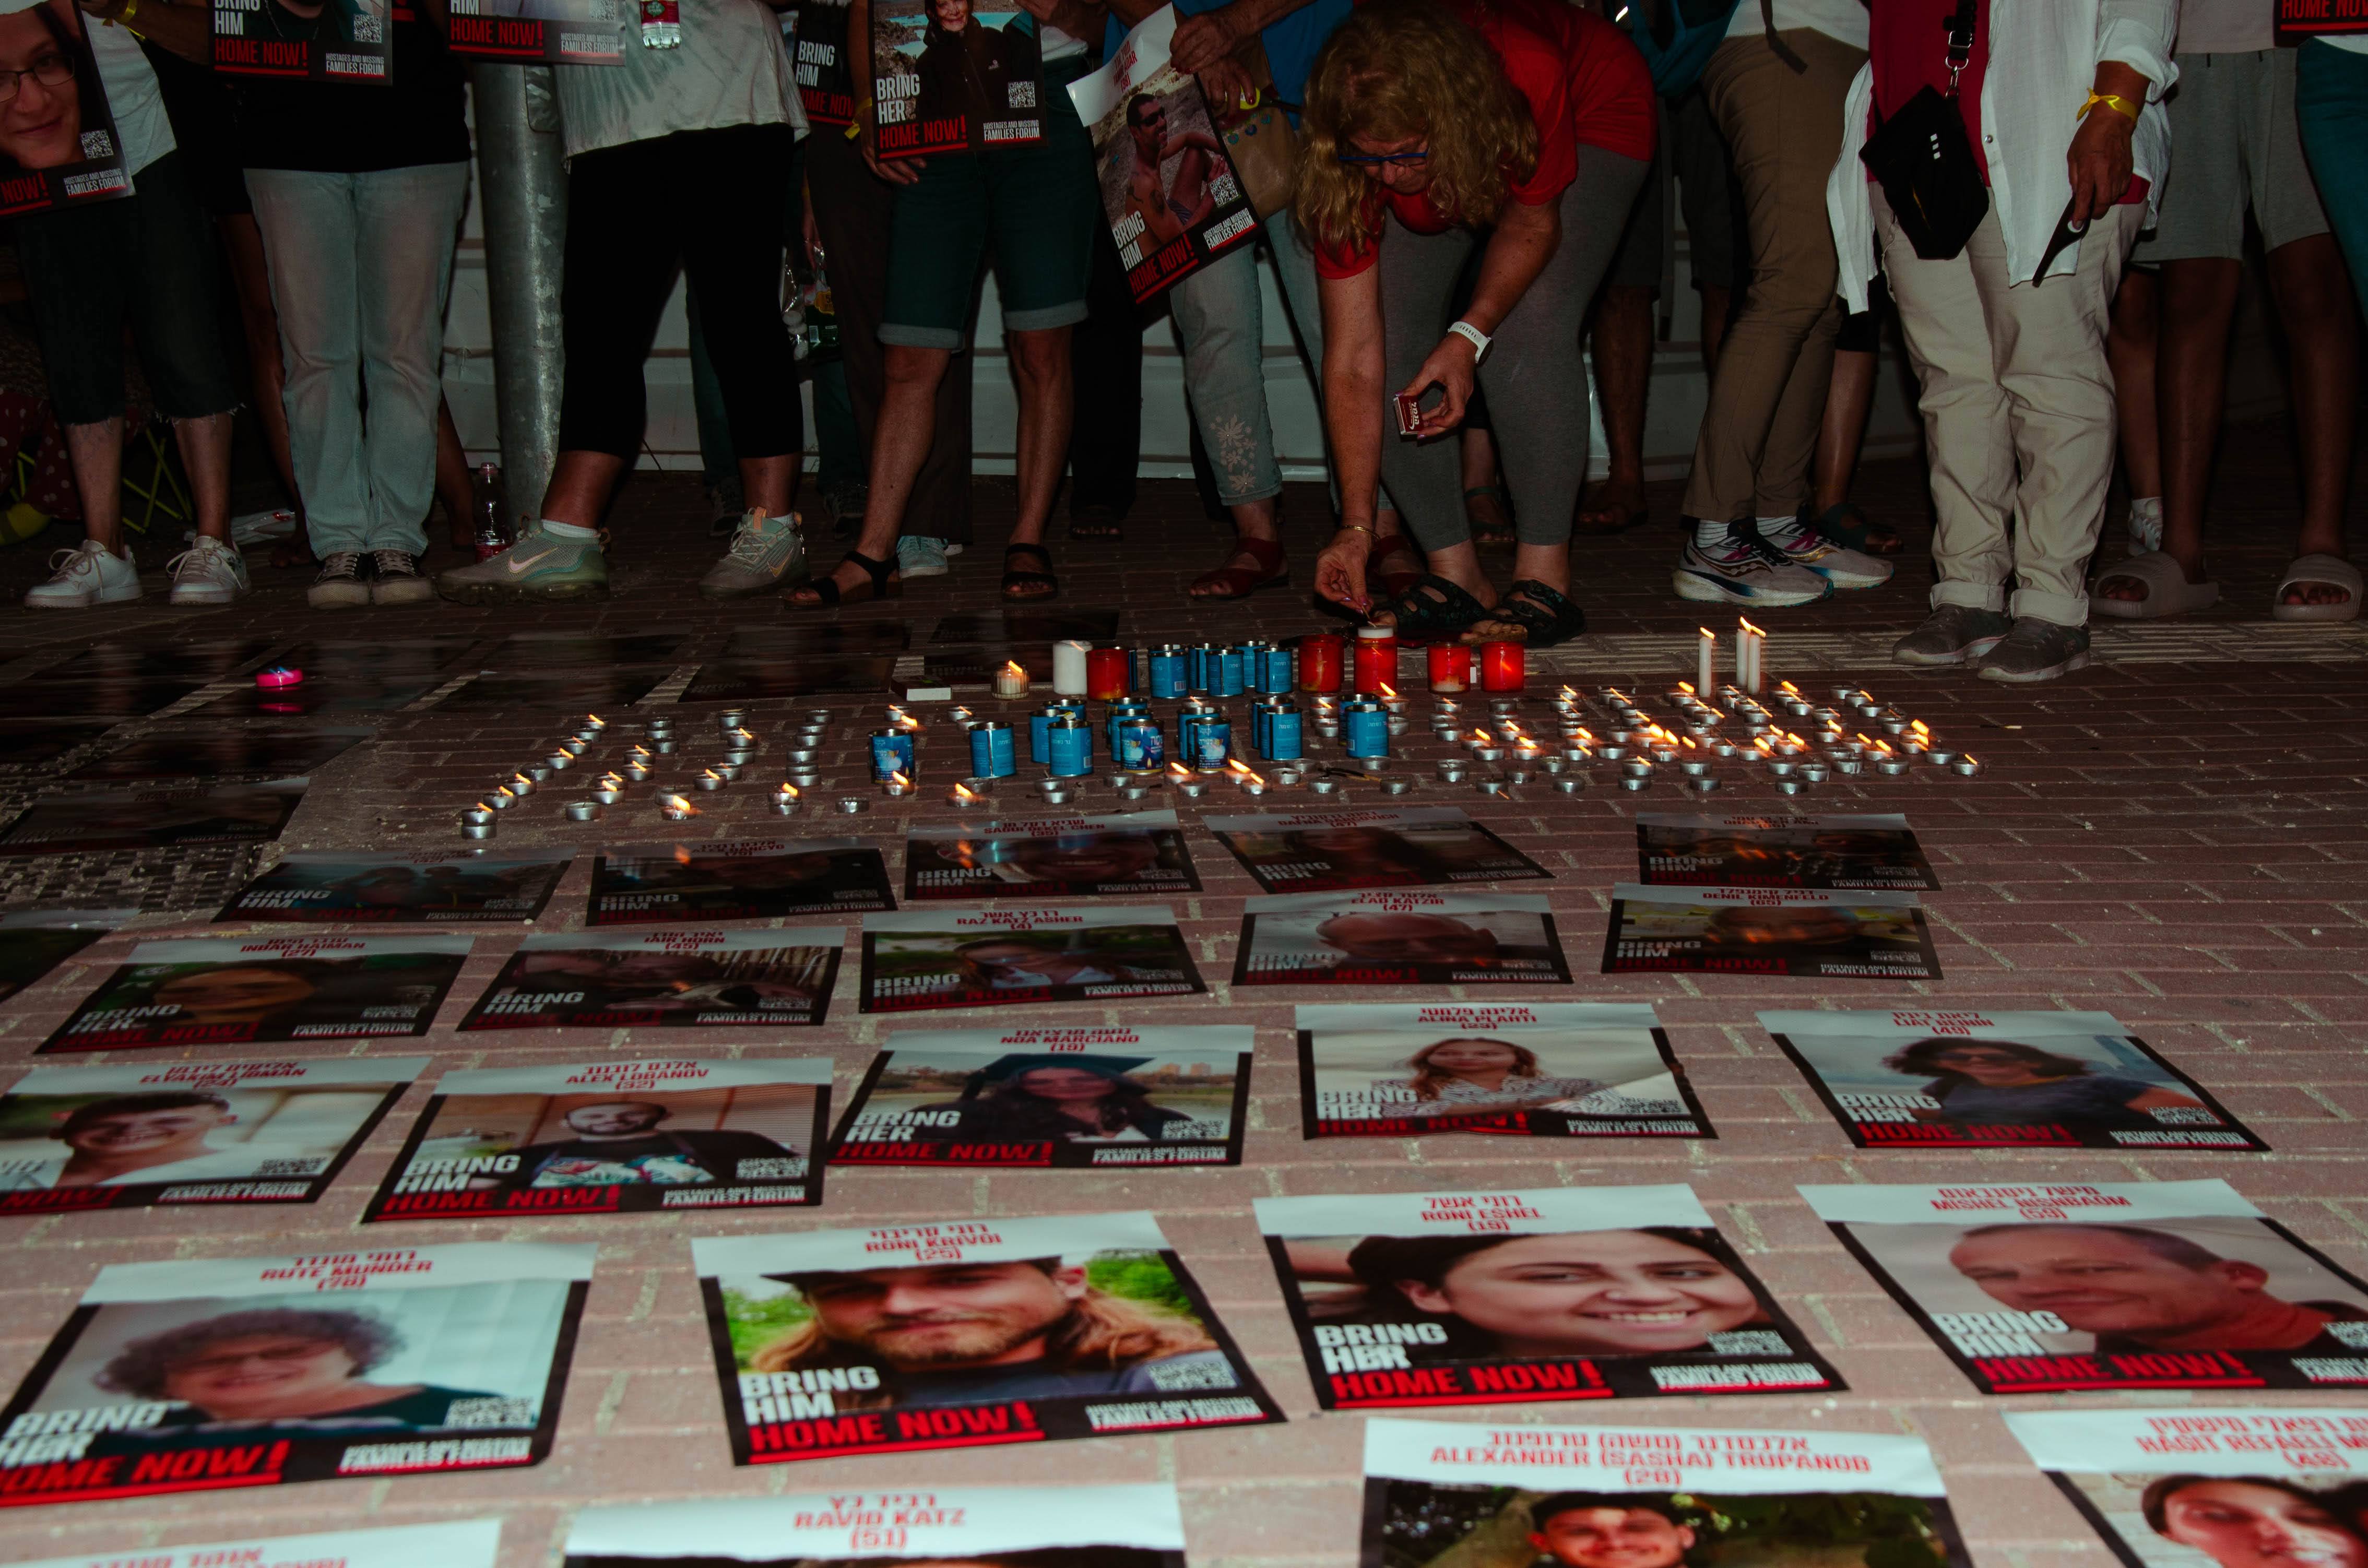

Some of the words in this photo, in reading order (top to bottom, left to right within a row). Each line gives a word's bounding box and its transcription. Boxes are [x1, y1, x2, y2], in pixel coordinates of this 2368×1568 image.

[2280, 0, 2331, 20] HOME
[215, 10, 244, 35] HIM
[451, 19, 493, 43] HOME
[498, 21, 543, 47] NOW!
[561, 32, 585, 42] HOSTAGES
[586, 33, 596, 42] AND
[597, 34, 618, 43] MISSING
[215, 38, 259, 64] HOME
[263, 41, 308, 67] NOW!
[561, 41, 593, 52] FAMILIES
[594, 42, 618, 53] FORUM
[797, 40, 835, 66] BRING
[326, 52, 351, 62] HOSTAGES
[351, 54, 361, 63] AND
[362, 55, 384, 64] MISSING
[326, 61, 358, 74] FAMILIES
[359, 62, 384, 75] FORUM
[796, 63, 819, 87] HIM
[877, 73, 920, 101] BRING
[878, 100, 906, 124] HER
[879, 123, 919, 150] HOME
[923, 114, 967, 144] NOW!
[983, 121, 1008, 129] HOSTAGES
[1008, 120, 1017, 129] AND
[1017, 119, 1039, 128] MISSING
[984, 128, 1014, 141] FAMILIES
[1015, 126, 1040, 139] FORUM
[63, 174, 89, 185] HOSTAGES
[89, 172, 99, 180] AND
[100, 168, 123, 179] MISSING
[66, 180, 101, 196] FAMILIES
[101, 175, 126, 189] FORUM
[1, 171, 49, 205] NOW!
[1112, 210, 1146, 250] BRING
[1203, 223, 1223, 240] HOSTAGES
[1223, 217, 1233, 229] AND
[1230, 207, 1250, 225] MISSING
[1206, 228, 1234, 250] FAMILIES
[1232, 215, 1254, 235] FORUM
[1119, 239, 1143, 272] HIM
[1128, 256, 1161, 295] HOME
[1157, 233, 1195, 275] NOW!
[917, 868, 992, 879] BRING
[1256, 862, 1332, 872] BRING
[1263, 871, 1316, 880] HER
[917, 878, 964, 886] HIM
[238, 898, 294, 908] HIM
[246, 890, 333, 899] BRING
[601, 894, 679, 902] BRING
[600, 902, 650, 911] HIM
[1616, 948, 1670, 957] HIM
[873, 973, 961, 988] BRING
[491, 992, 585, 1003] BRING
[482, 1003, 544, 1014] HIM
[1043, 1034, 1140, 1043] MARCIANO
[230, 1068, 307, 1080] LIBMAN
[567, 1073, 615, 1083] ALEX
[1316, 1089, 1419, 1102] BRING
[1832, 1095, 1943, 1110] BRING
[853, 1110, 962, 1127] BRING
[1317, 1102, 1383, 1120] HER
[1845, 1107, 1919, 1123] HER
[844, 1125, 916, 1143] HER
[1856, 1122, 1964, 1140] HOME
[835, 1143, 939, 1158] HOME
[948, 1141, 1053, 1161] NOW!
[403, 1155, 522, 1177] BRING
[393, 1173, 471, 1194] HIM
[383, 1191, 498, 1212] HOME
[506, 1184, 621, 1207] NOW!
[1931, 1199, 2013, 1210] MISHEL
[1422, 1210, 1473, 1221] RONI
[1478, 1207, 1545, 1219] ESHEL
[2018, 1207, 2068, 1220] (59)
[1467, 1219, 1510, 1231] (19)
[865, 1240, 918, 1252] RONI
[926, 1233, 1002, 1247] KRIVOI
[915, 1245, 963, 1262] (25)
[261, 1267, 323, 1279] RUTE
[330, 1260, 432, 1276] MUNDER
[316, 1274, 368, 1291] (78)
[1930, 1310, 2070, 1334] BRING
[1313, 1322, 1449, 1347] BRING
[1949, 1332, 2049, 1359] HIM
[1320, 1344, 1414, 1376] HER
[1972, 1357, 2112, 1383] HOME
[2112, 1349, 2255, 1379] NOW!
[738, 1365, 881, 1398] BRING
[1331, 1367, 1464, 1401] HOME
[1469, 1359, 1607, 1393] NOW!
[742, 1391, 837, 1426] HIM
[3, 1403, 170, 1436] BRING
[749, 1413, 889, 1452] HOME
[896, 1400, 1038, 1440] NOW!
[1088, 1410, 1186, 1430] FAMILIES
[1185, 1406, 1263, 1424] FORUM
[2136, 1435, 2219, 1452] HAGIT
[2224, 1435, 2336, 1451] REFAELI
[129, 1439, 293, 1483] NOW!
[1431, 1447, 1591, 1466] ALEXANDER
[1601, 1449, 1714, 1467] (SASHA)
[1722, 1452, 1870, 1472] TRUPANOB
[2279, 1450, 2350, 1469] (48)
[1624, 1469, 1682, 1485] (28)
[829, 1495, 864, 1510] כץ
[795, 1511, 883, 1527] RAVID
[894, 1509, 964, 1525] KATZ
[852, 1530, 905, 1548] (51)
